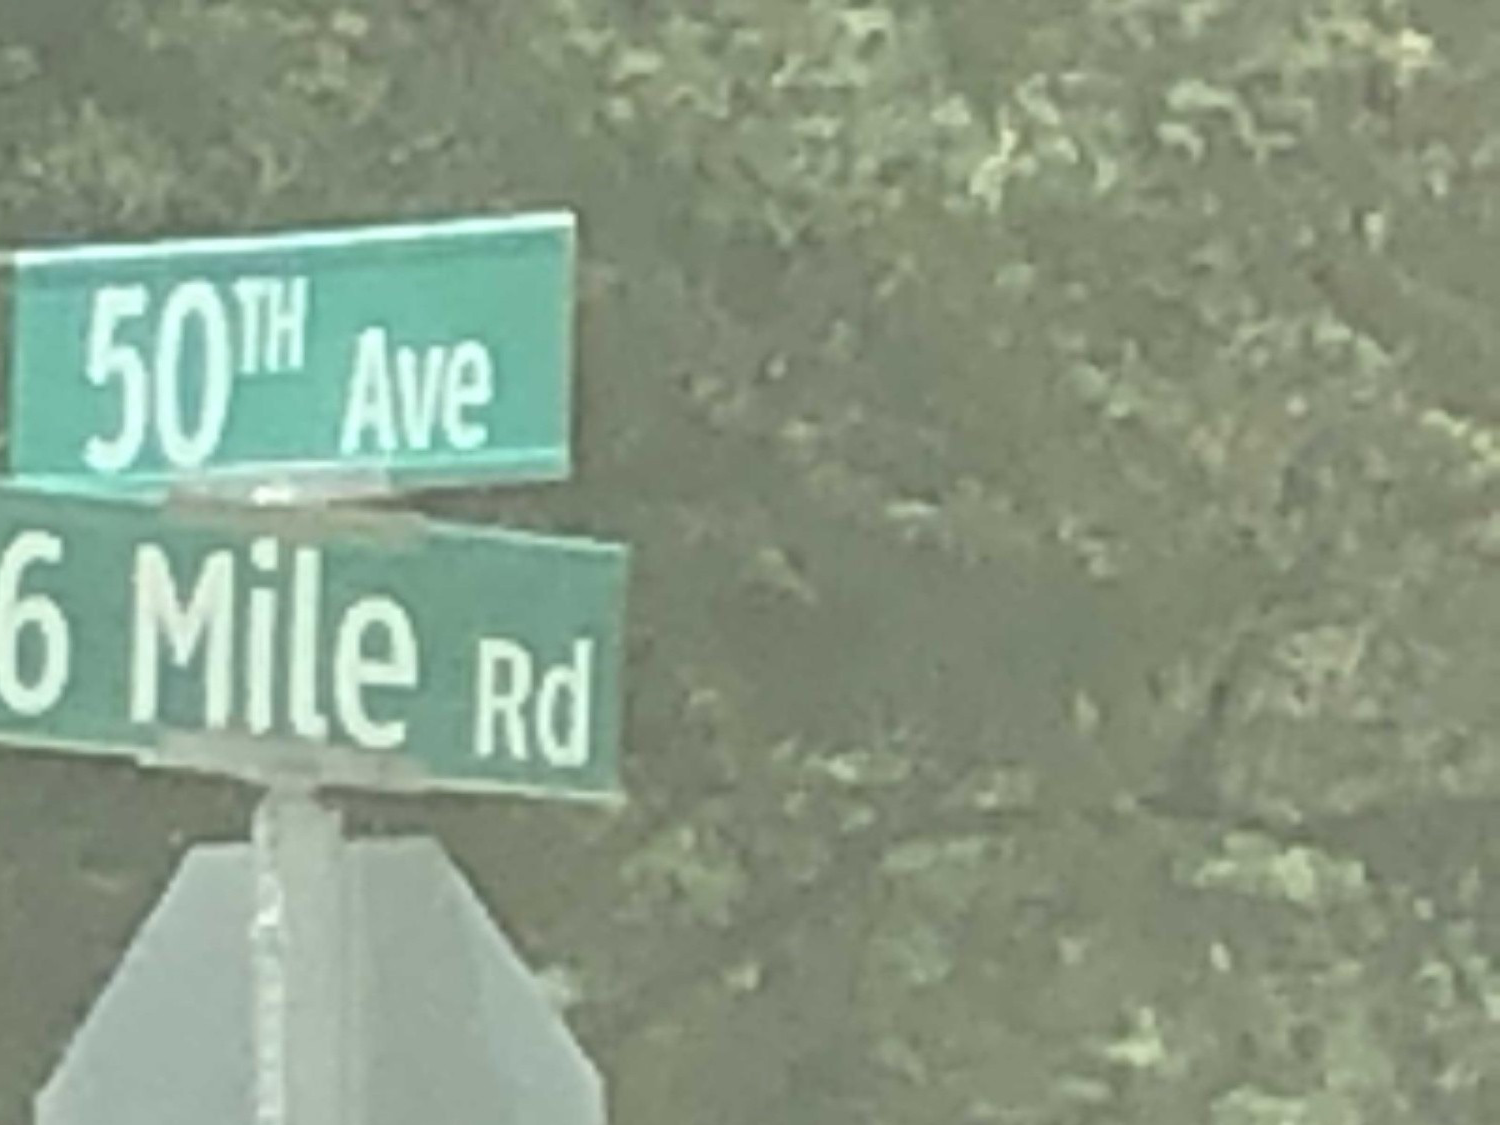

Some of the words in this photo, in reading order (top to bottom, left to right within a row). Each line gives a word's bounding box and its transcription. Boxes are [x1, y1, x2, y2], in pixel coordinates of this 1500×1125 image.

[83, 276, 308, 473] 50TH
[340, 326, 493, 453] Ave
[129, 537, 418, 749] Mile
[474, 637, 593, 766] Rd
